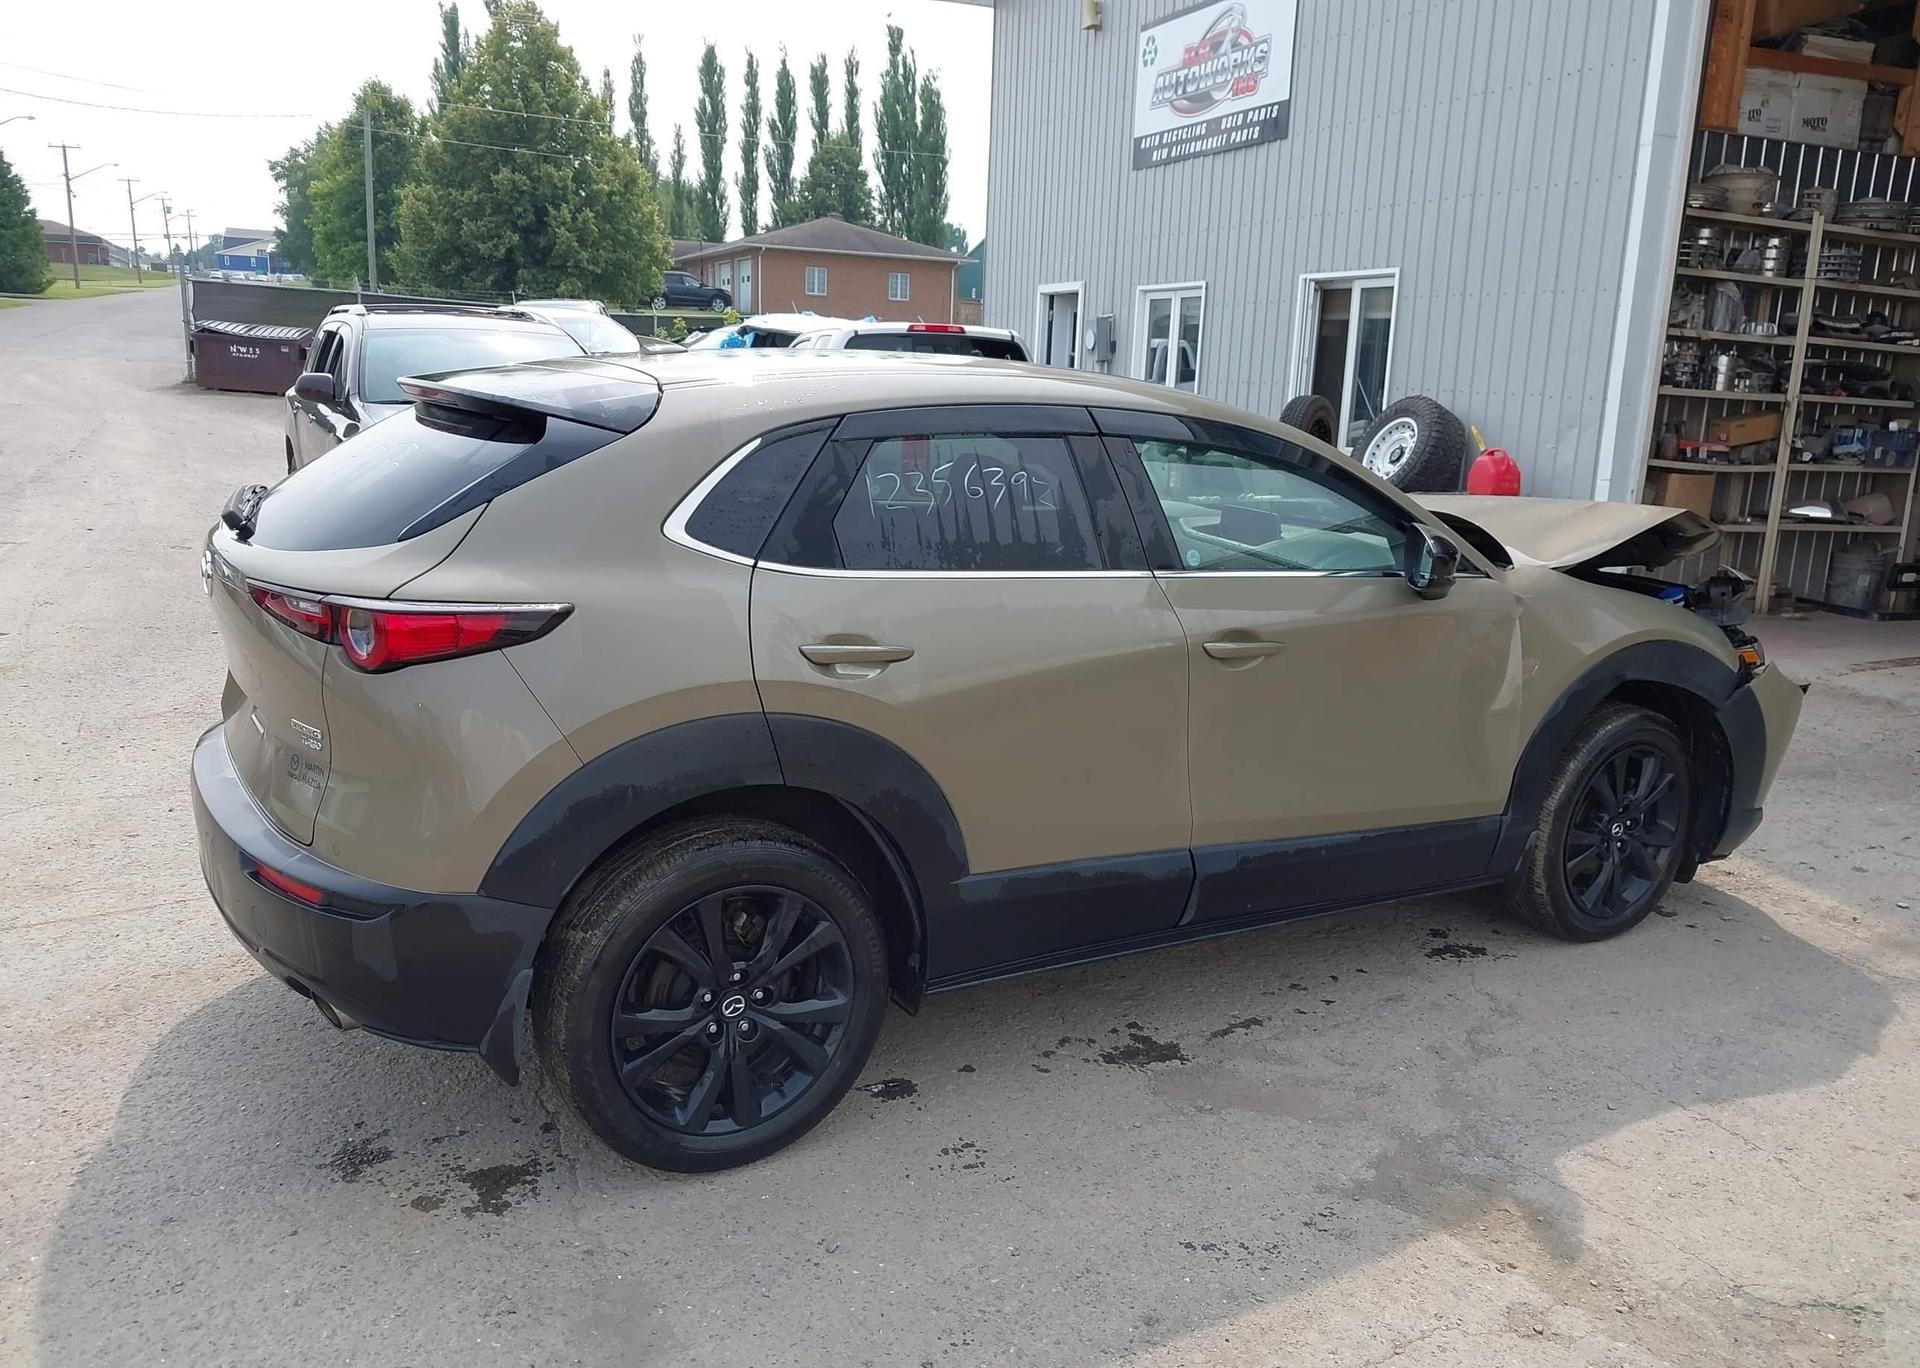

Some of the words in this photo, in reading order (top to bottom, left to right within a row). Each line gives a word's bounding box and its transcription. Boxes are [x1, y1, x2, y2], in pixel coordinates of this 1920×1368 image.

[1152, 42, 1269, 103] AUTOWORKS
[1140, 134, 1160, 149] AUTO
[1162, 122, 1208, 146] RECYCLING
[1220, 114, 1244, 131] USED
[1246, 104, 1280, 124] PARTS
[1152, 146, 1169, 162] NEW
[1170, 133, 1228, 158] AFTERMARKET
[1229, 126, 1261, 146] PARTS
